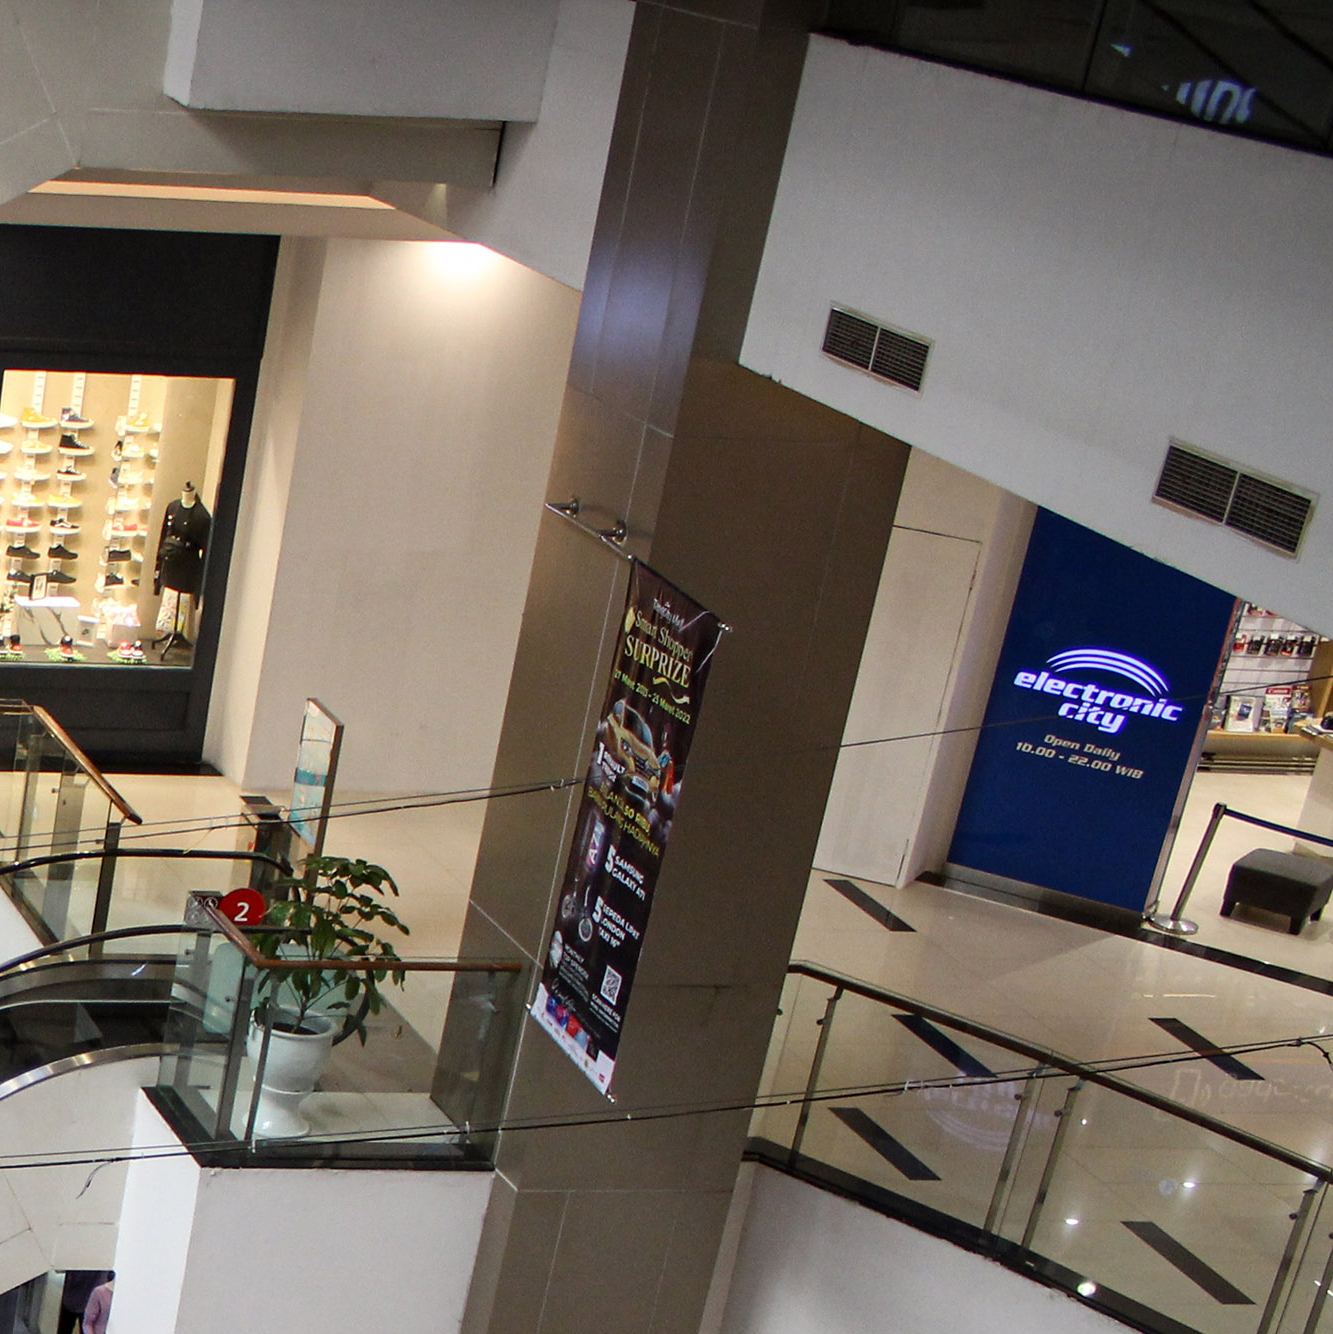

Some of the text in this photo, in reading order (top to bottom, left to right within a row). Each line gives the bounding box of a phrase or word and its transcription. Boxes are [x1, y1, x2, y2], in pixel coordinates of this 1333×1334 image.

[624, 634, 692, 689] SURPRIZE
[658, 626, 694, 663] Shopper
[1013, 671, 1183, 721] electronic
[1058, 702, 1125, 734] city
[1015, 741, 1056, 759] 10.00
[1067, 753, 1112, 773] 22.00
[1114, 764, 1145, 779] WIB
[1044, 734, 1121, 762] Open Daily
[233, 902, 250, 922] 2
